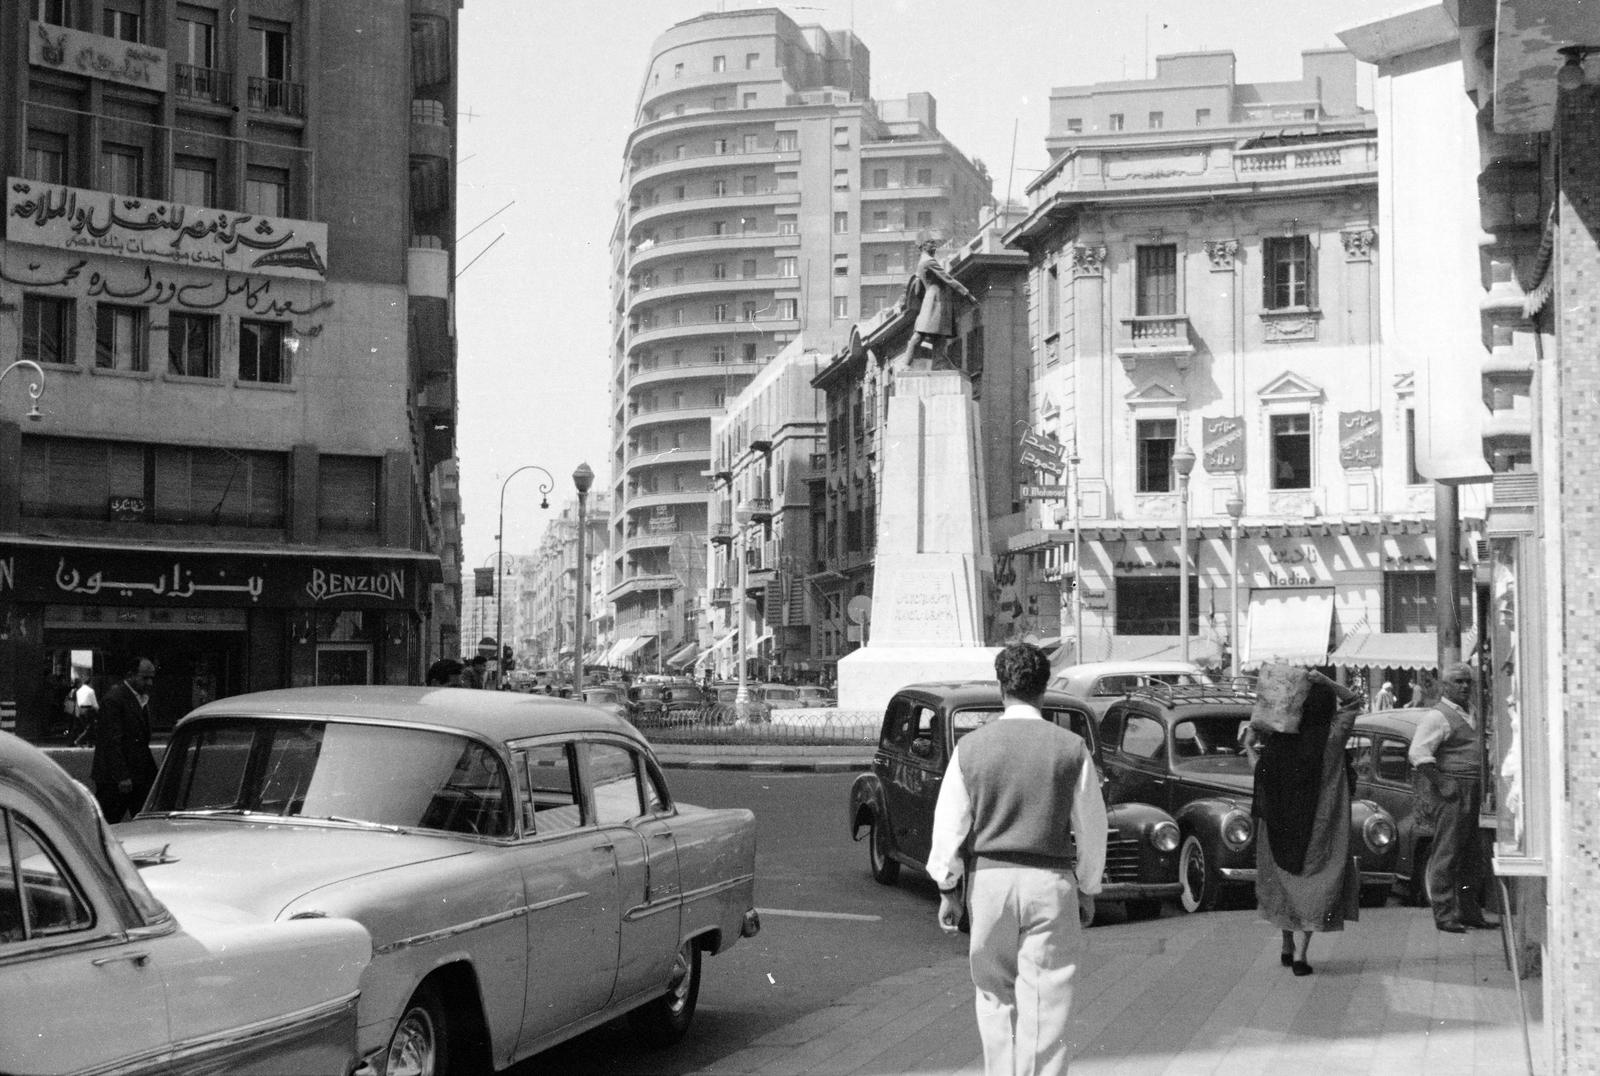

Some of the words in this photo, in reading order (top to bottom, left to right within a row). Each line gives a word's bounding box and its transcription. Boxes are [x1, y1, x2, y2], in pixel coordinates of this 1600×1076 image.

[86, 195, 185, 238] للنقل
[98, 233, 124, 254] بنك
[170, 219, 218, 249] مصر
[214, 213, 294, 254] شركة
[254, 298, 335, 316] سعيد
[55, 556, 264, 602] بنزايون
[306, 567, 405, 601] BENZION
[1268, 571, 1316, 586] Nadine
